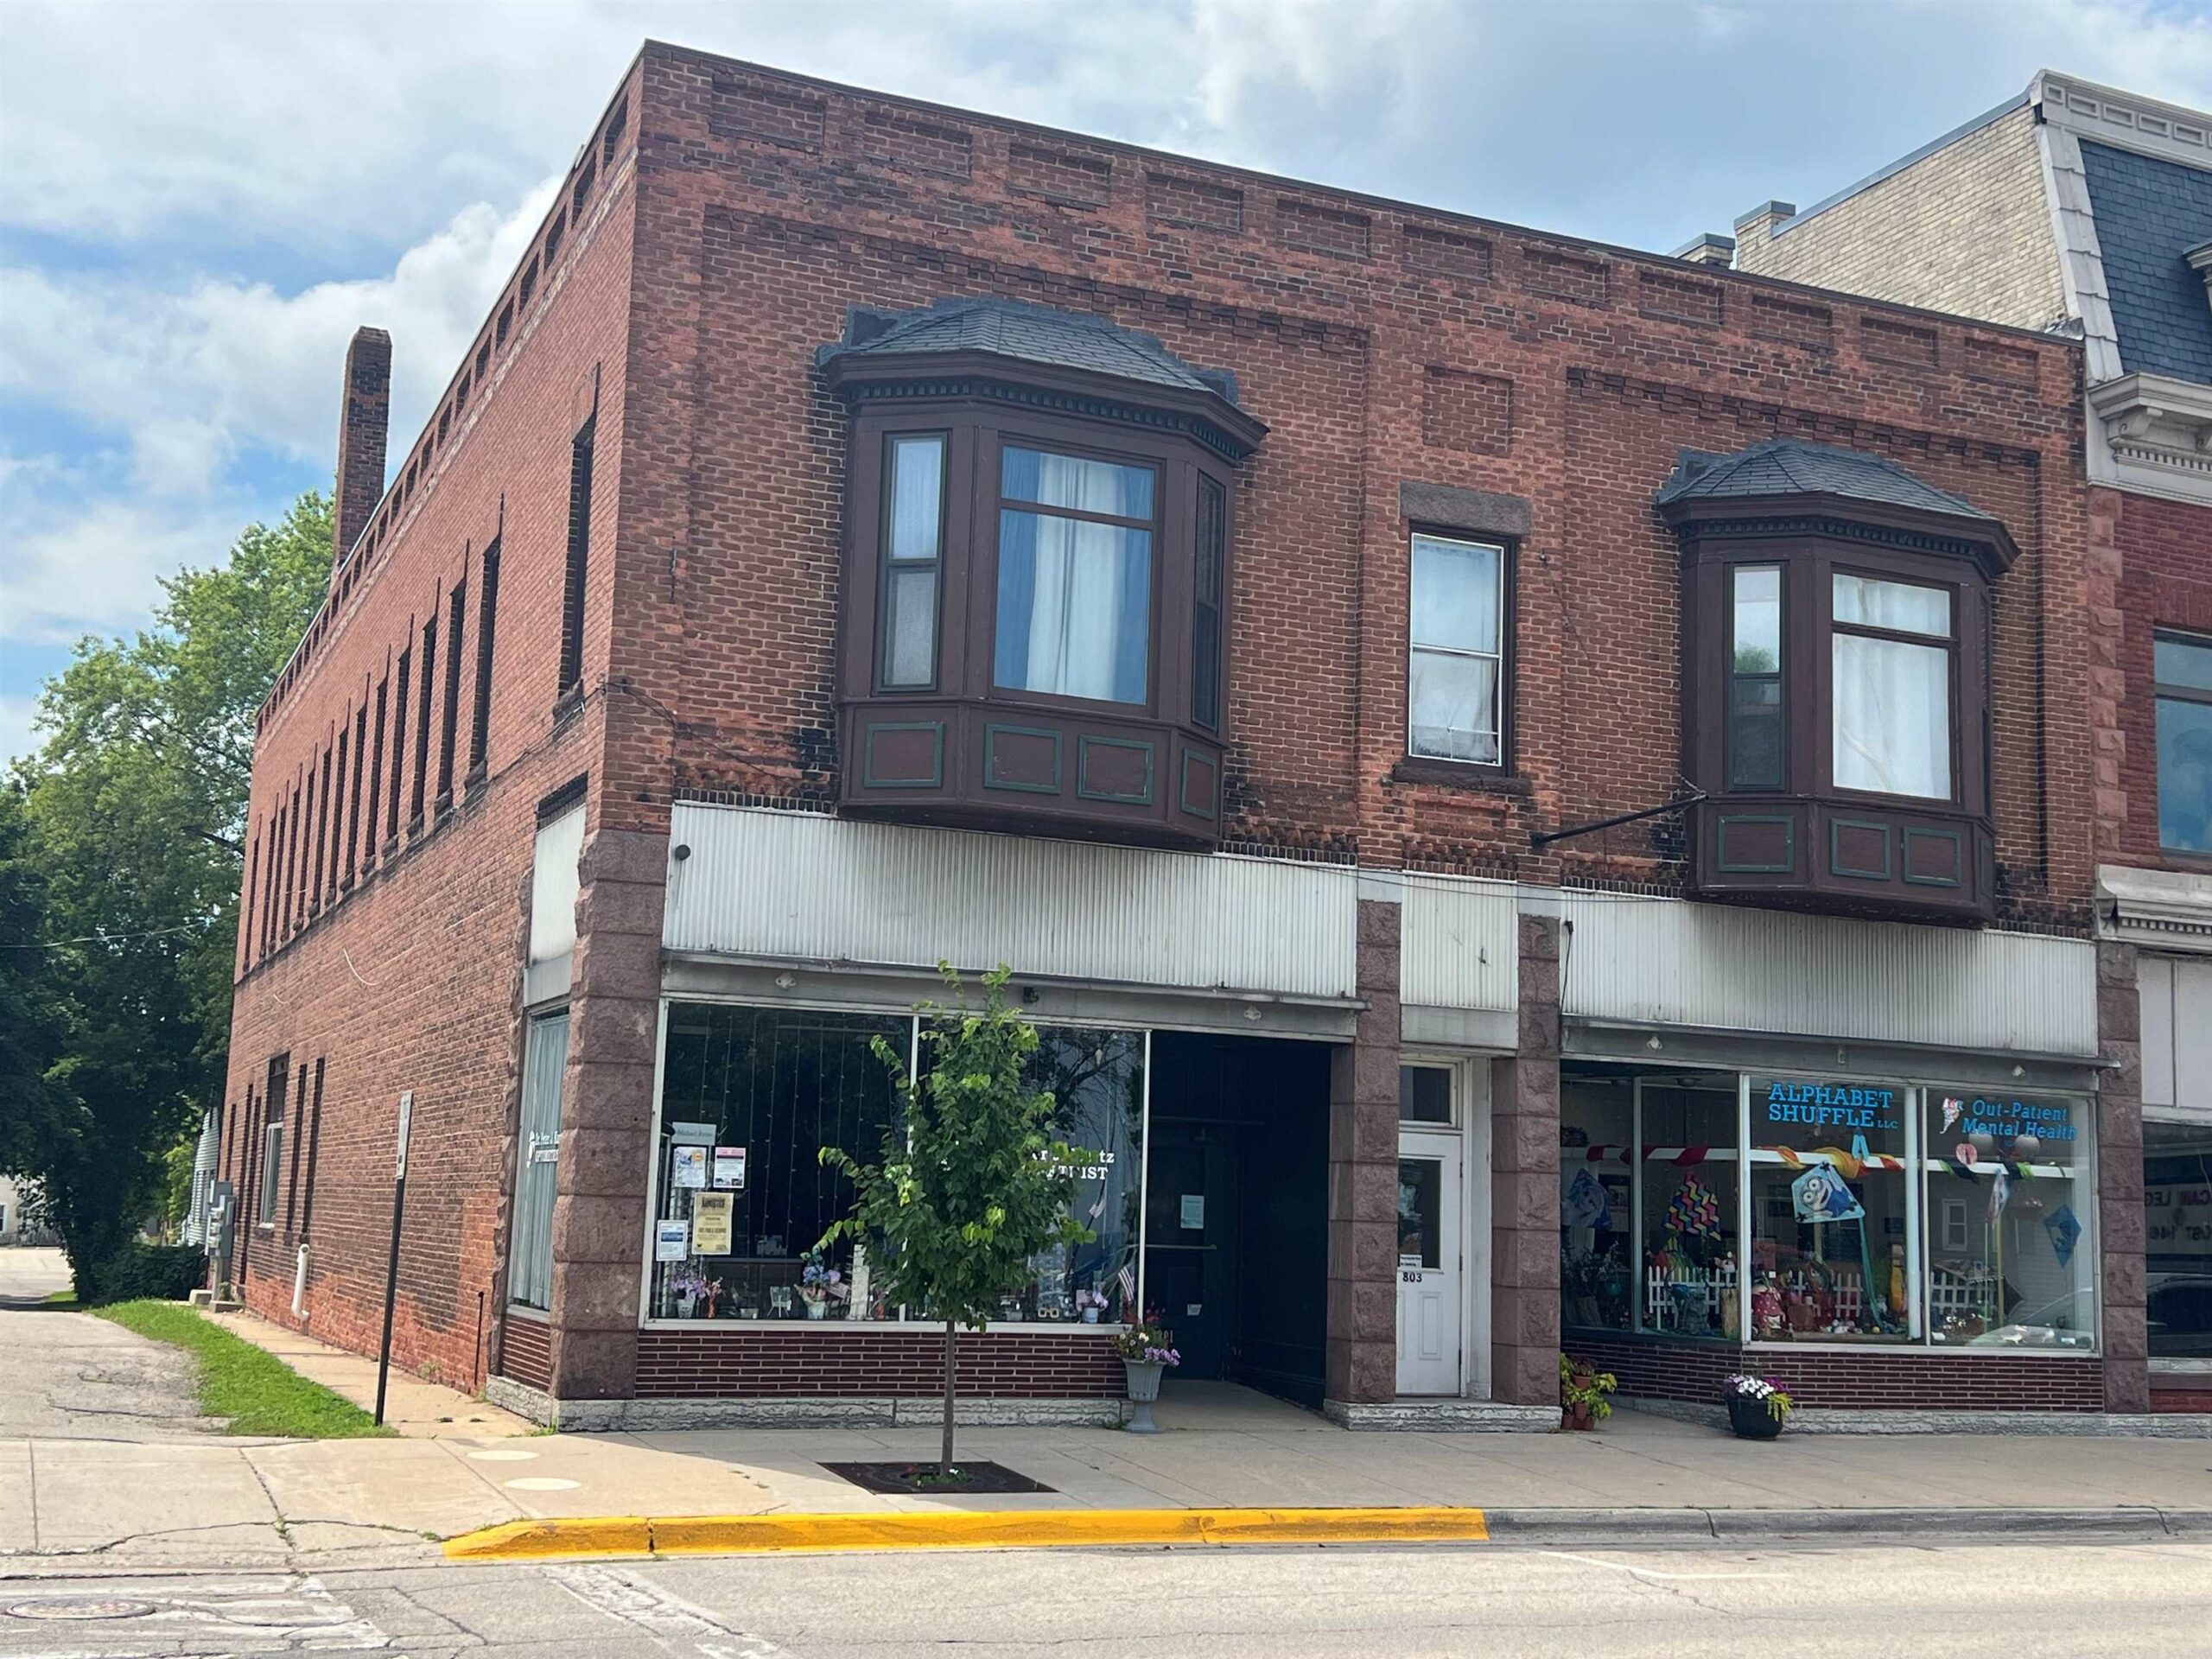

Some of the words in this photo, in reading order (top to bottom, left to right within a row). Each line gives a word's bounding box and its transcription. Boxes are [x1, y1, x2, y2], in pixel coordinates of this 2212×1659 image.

[1769, 1083, 1893, 1109] ALPHABET
[1769, 1103, 1874, 1128] SHUFFLE
[1877, 1119, 1898, 1128] LLC
[1972, 1099, 2068, 1122] Out-Patient
[1961, 1117, 2019, 1136] Mental
[2024, 1122, 2079, 1141] Health
[1402, 1272, 1422, 1282] 803
